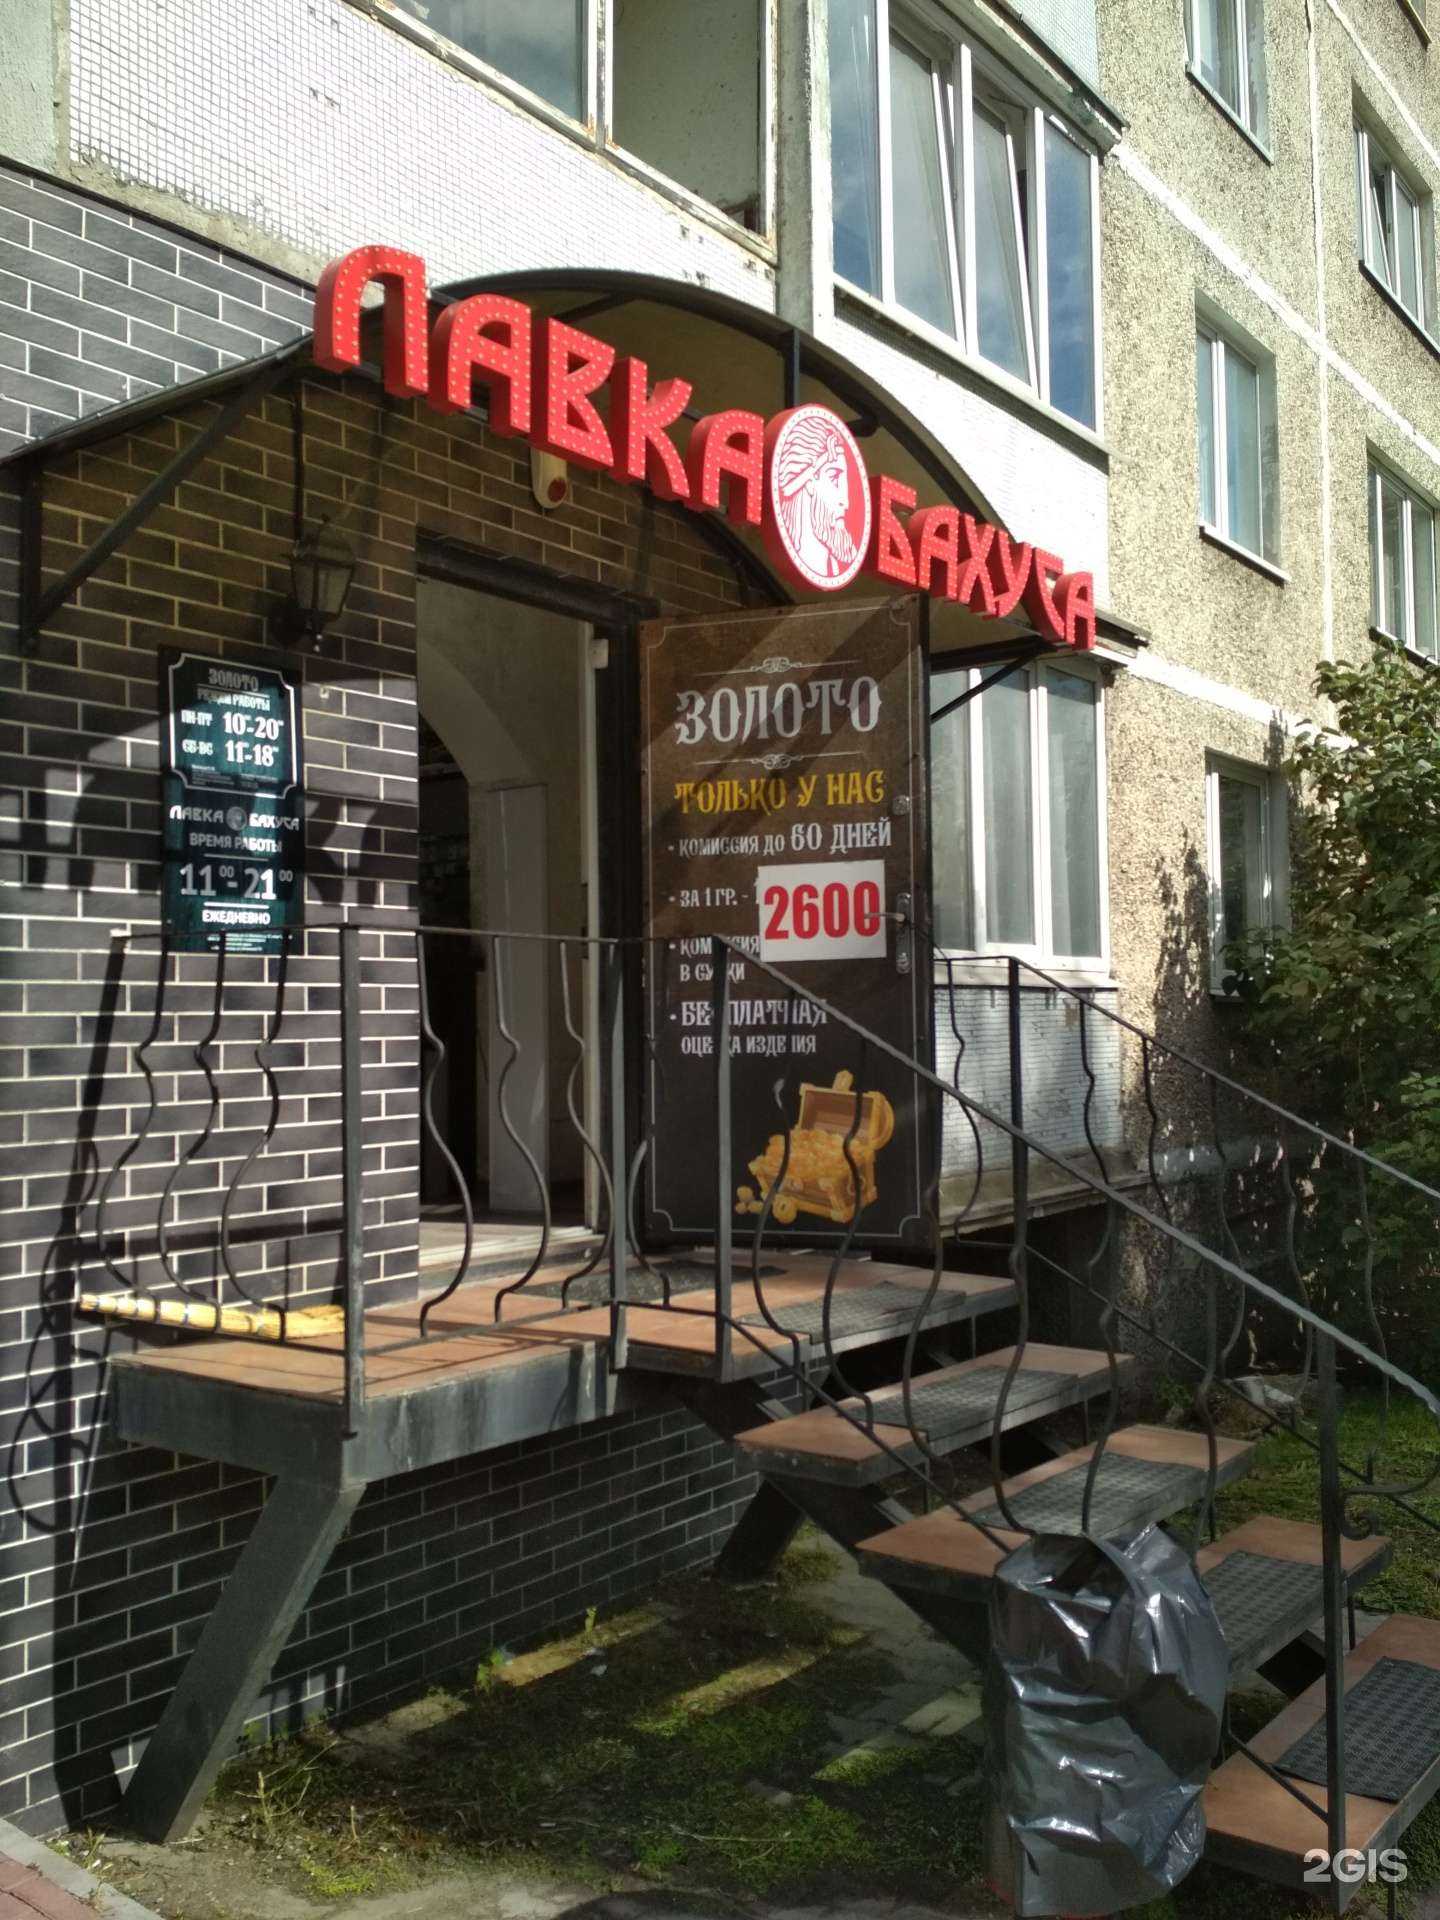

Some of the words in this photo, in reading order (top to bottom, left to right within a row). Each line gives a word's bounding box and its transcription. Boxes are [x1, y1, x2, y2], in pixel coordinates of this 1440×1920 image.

[314, 244, 765, 527] ЛАВКА
[869, 474, 1097, 650] БАХУСА
[208, 668, 259, 692] ЗОЛОТО
[232, 694, 270, 711] РАБОТЫ
[674, 676, 882, 744] ЗОЛОТО
[181, 709, 213, 726] ПН-ПТ
[181, 739, 213, 755] СБ-ВС
[674, 776, 787, 816] ТОЛЬКО
[798, 775, 817, 807] У
[826, 770, 885, 805] НАС
[169, 805, 224, 823] ЛАВКА
[248, 812, 300, 831] БАХУСА
[189, 832, 232, 848] ВРЕМЯ
[233, 836, 283, 853] РАБОТЫ
[678, 835, 759, 857] КОМИССИЯ
[763, 835, 786, 856] ДО
[790, 823, 823, 850] 60
[829, 817, 892, 854] ДНЕЙ
[679, 889, 700, 907] ЗА
[704, 887, 711, 906] 1
[714, 888, 738, 906] ГР.
[202, 910, 271, 925] ЕЖЕДНЕВНО
[763, 881, 881, 940] 2600
[680, 934, 760, 958] КОМСИЯ
[679, 964, 691, 981] В
[694, 963, 745, 984] СУКИ
[681, 1000, 828, 1027] БЕПЛАТНАЯ
